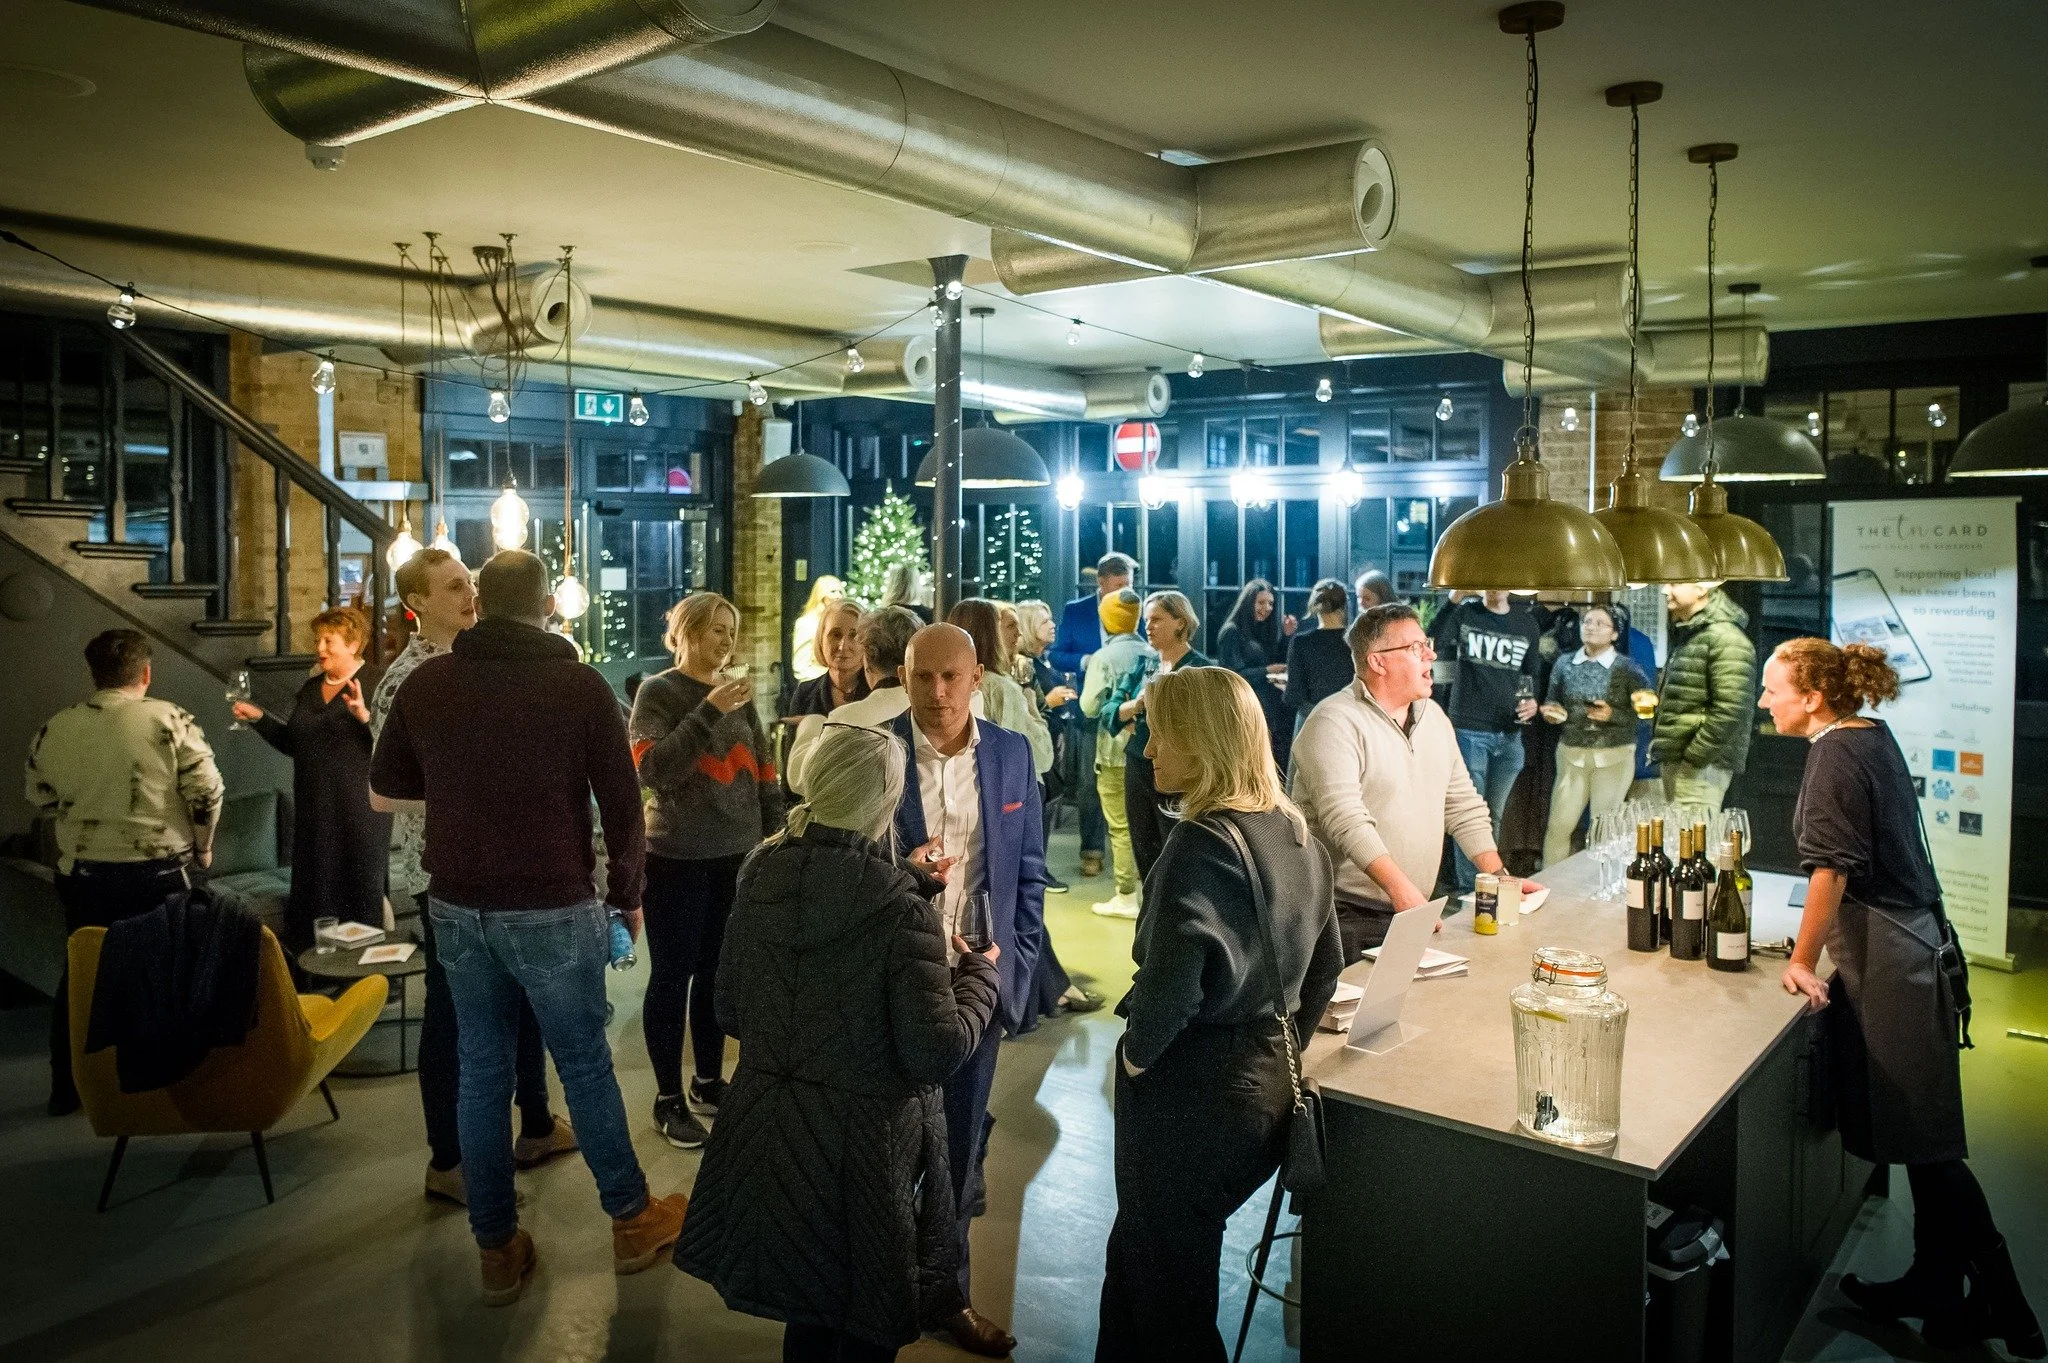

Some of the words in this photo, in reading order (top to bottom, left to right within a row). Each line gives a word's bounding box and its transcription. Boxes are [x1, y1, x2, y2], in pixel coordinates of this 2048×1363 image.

[1857, 525, 1891, 538] THE
[1933, 523, 1988, 538] CARD
[1893, 567, 1962, 582] Supporting
[1964, 566, 1997, 579] local
[1900, 586, 1922, 596] has
[1926, 588, 1959, 597] never
[1963, 586, 1996, 598] been
[1913, 607, 1927, 616] so
[1930, 605, 1995, 620] rewarding
